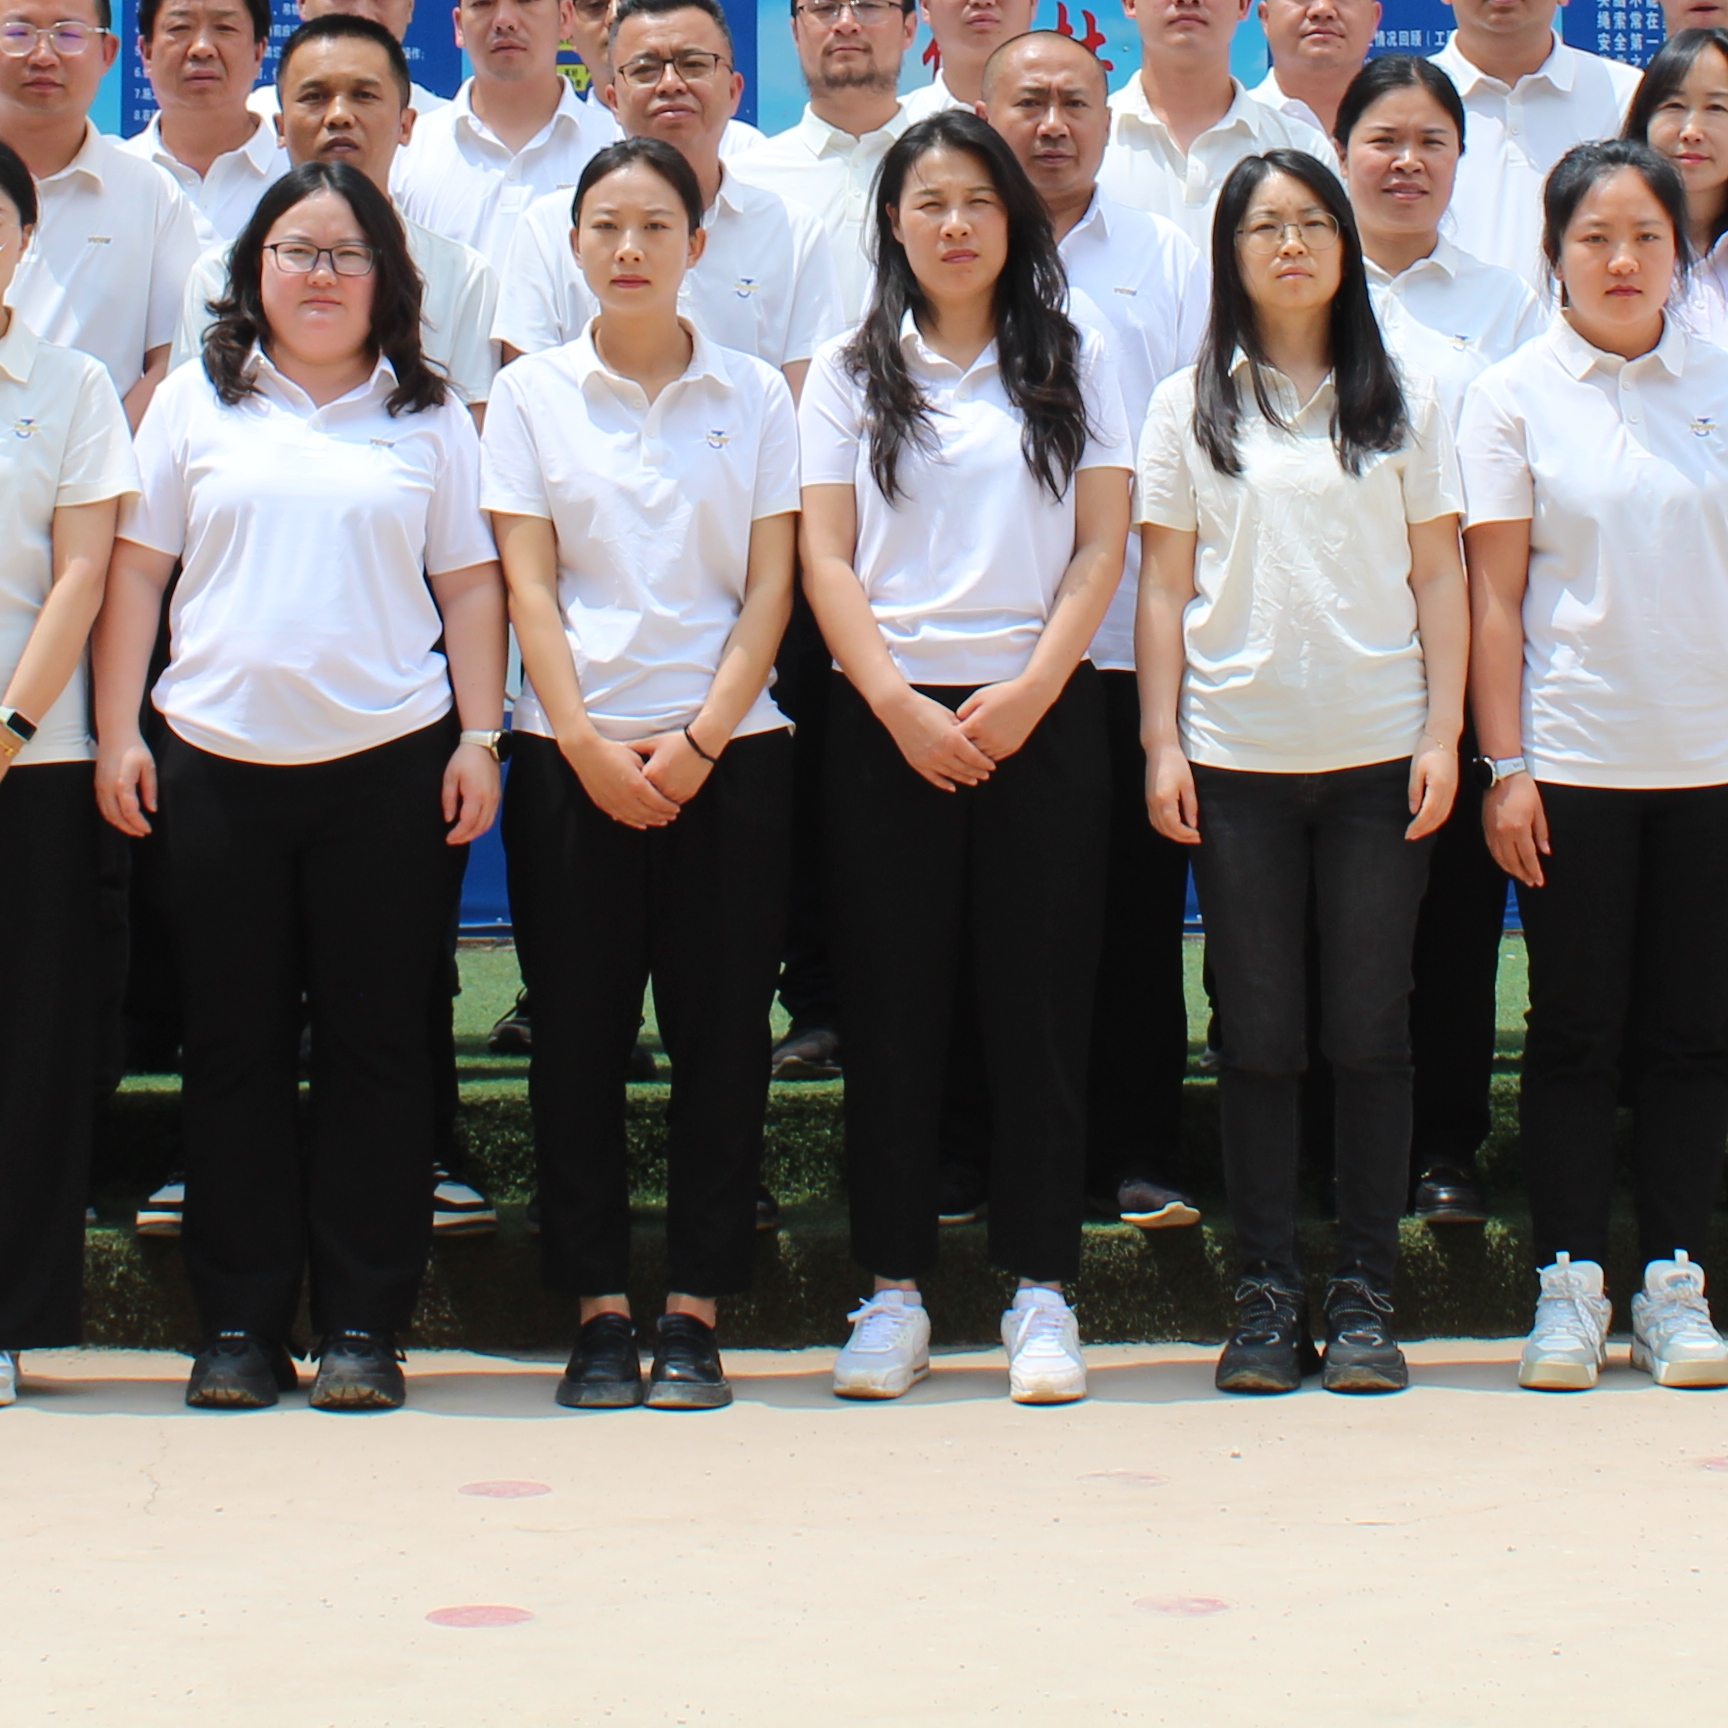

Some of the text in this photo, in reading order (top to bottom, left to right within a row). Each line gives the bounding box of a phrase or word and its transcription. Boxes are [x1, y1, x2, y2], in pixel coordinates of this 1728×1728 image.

[1597, 11, 1666, 30] 绳索常在
[1597, 32, 1667, 51] 安全第一
